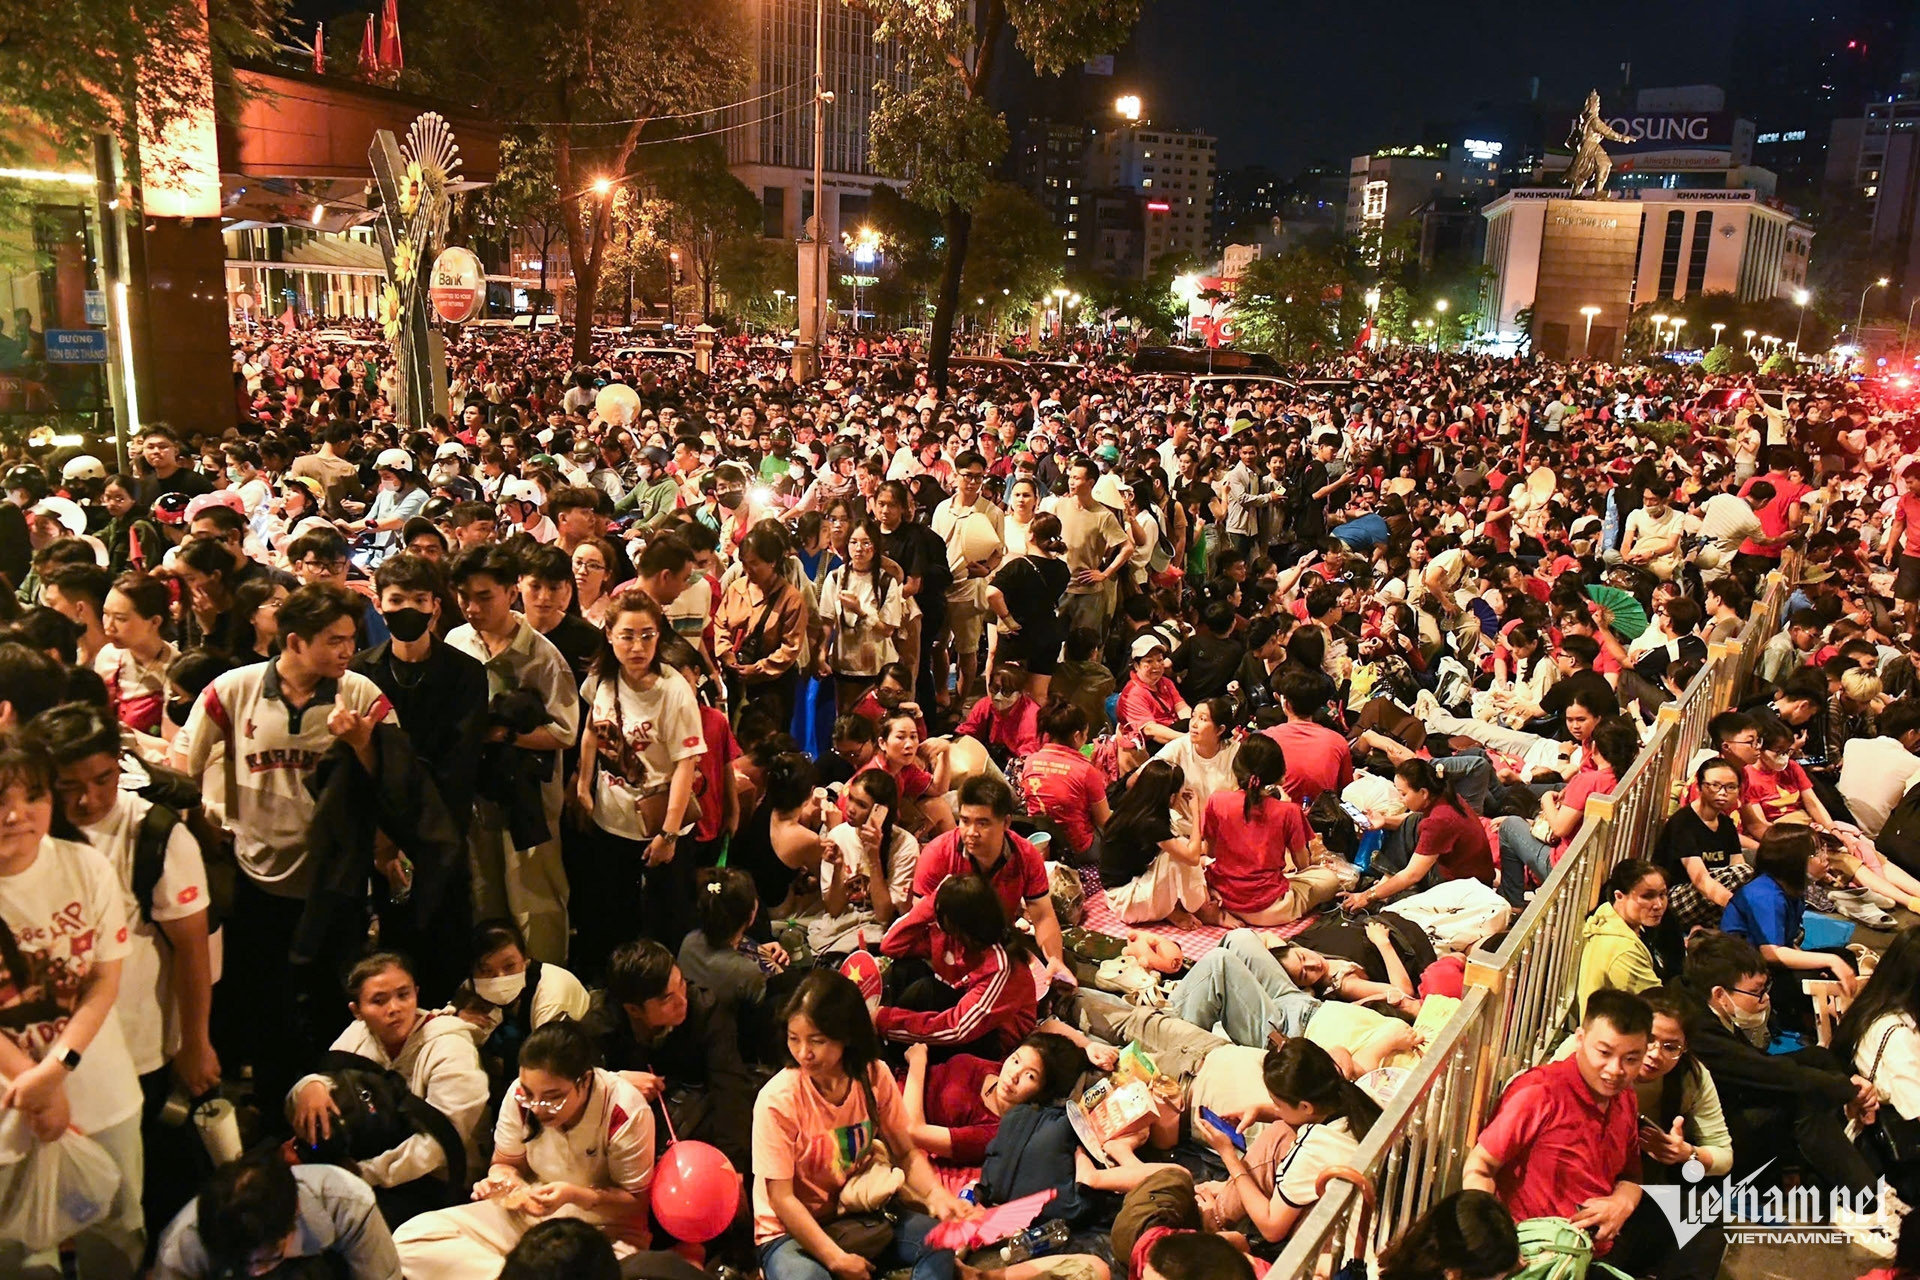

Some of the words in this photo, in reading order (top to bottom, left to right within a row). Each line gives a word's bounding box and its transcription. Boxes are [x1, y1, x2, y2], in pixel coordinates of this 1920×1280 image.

[1572, 117, 1709, 141] OSUNG
[1676, 192, 1699, 200] KHAI
[1700, 192, 1726, 200] HOAN
[439, 273, 462, 286] Bank
[1702, 851, 1725, 861] NICE
